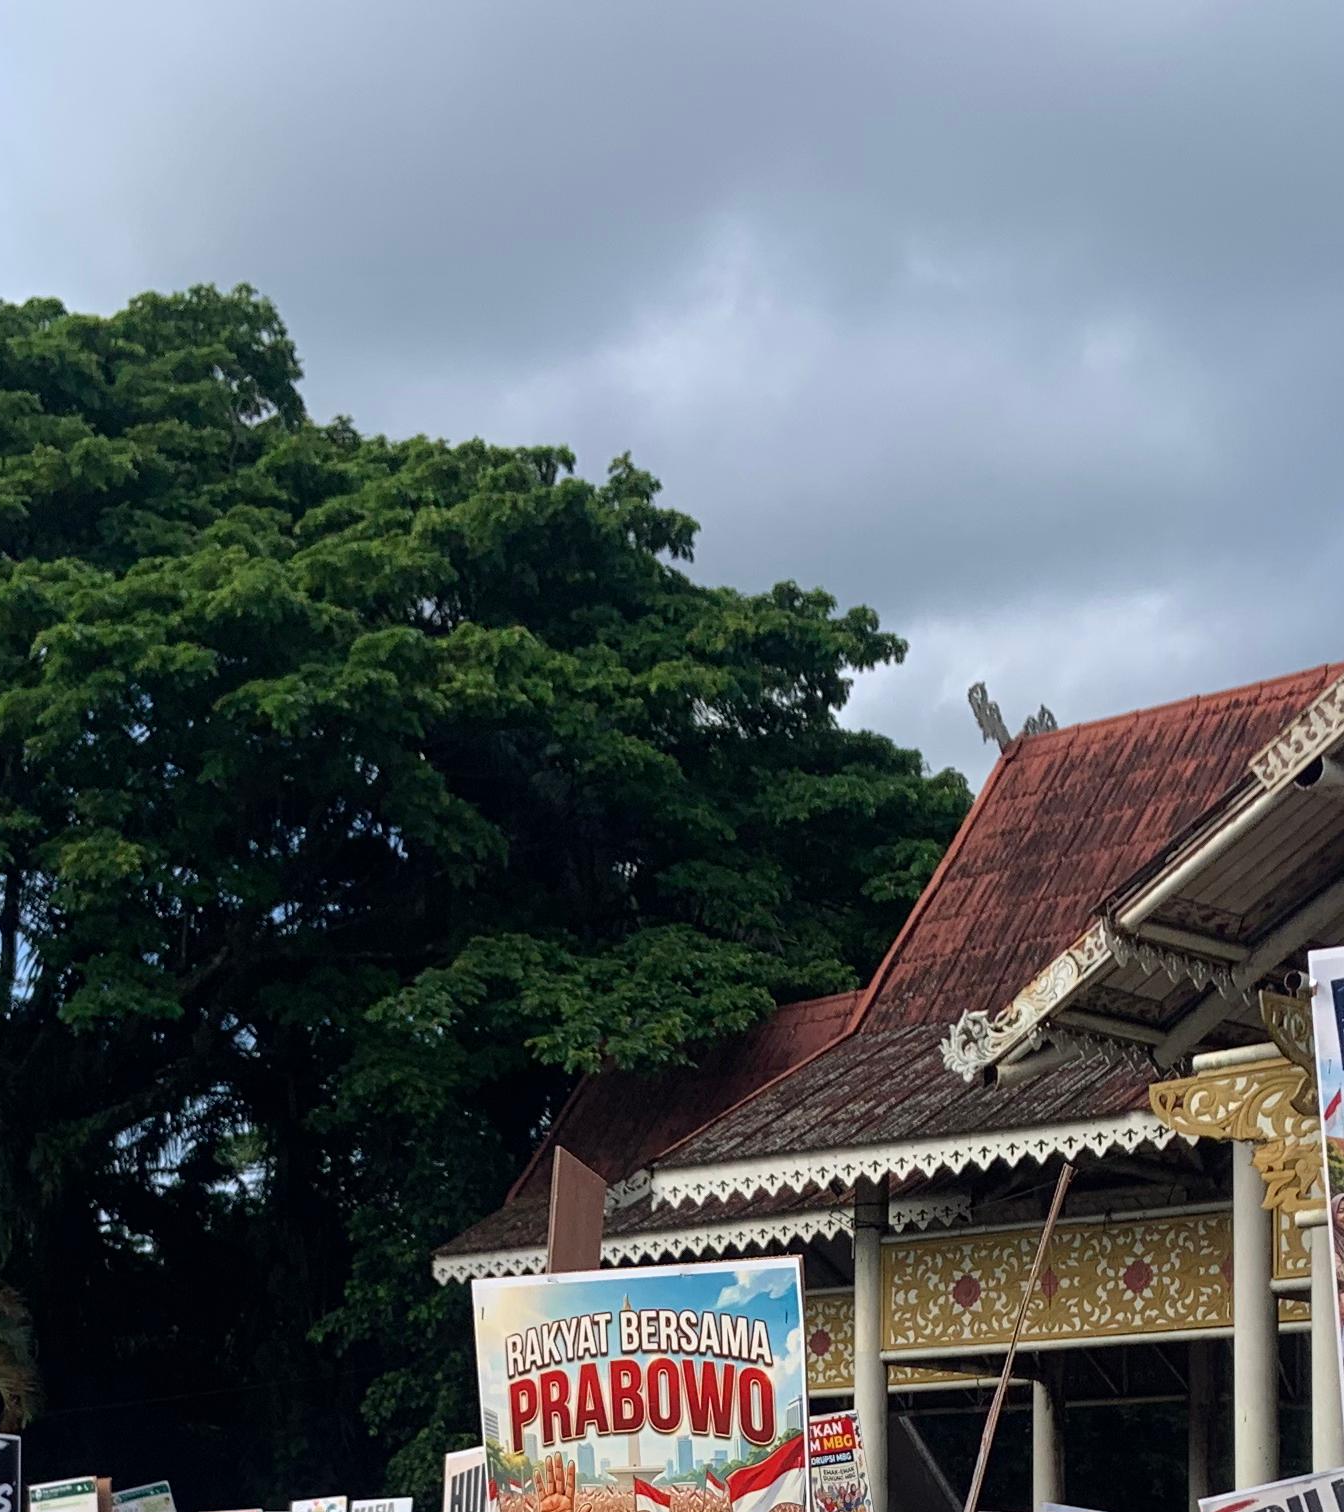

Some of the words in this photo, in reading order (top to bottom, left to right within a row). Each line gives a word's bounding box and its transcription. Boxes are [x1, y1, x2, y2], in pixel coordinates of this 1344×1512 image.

[506, 1312, 612, 1378] RAKYAT
[619, 1310, 773, 1366] BERSAMA
[509, 1358, 776, 1452] PRABOWO
[823, 1436, 853, 1451] MBG
